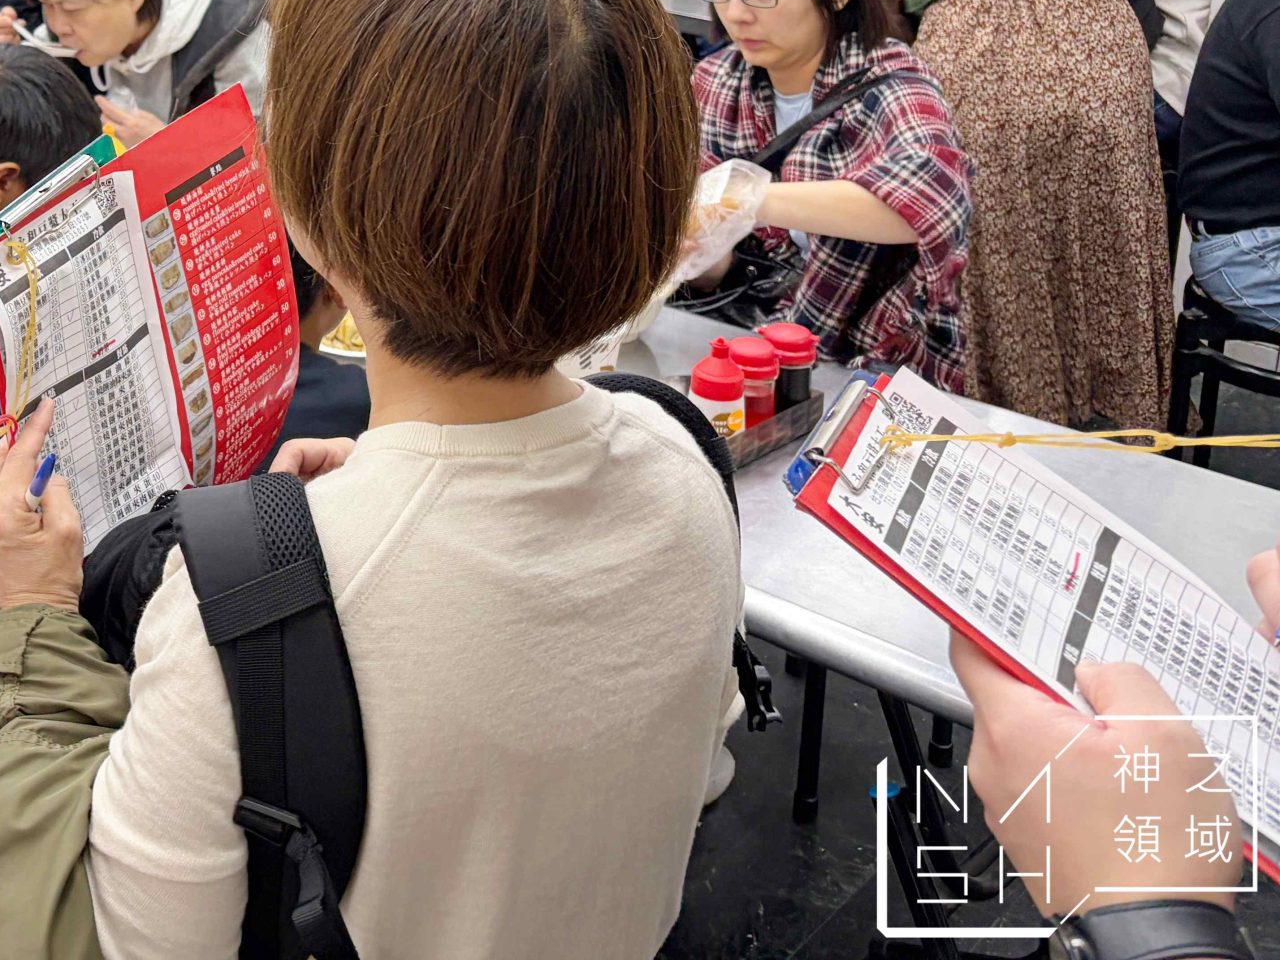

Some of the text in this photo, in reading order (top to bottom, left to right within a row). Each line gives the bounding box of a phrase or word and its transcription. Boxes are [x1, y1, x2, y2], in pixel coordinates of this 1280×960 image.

[256, 183, 265, 195] 60
[228, 207, 271, 241] cake 40
[252, 230, 277, 252] cake 50
[245, 272, 257, 285] cake
[271, 254, 281, 266] 60
[47, 273, 56, 285] 25
[247, 277, 285, 311] cake 30
[279, 300, 289, 313] 50
[51, 319, 60, 332] 35
[283, 323, 292, 336] 40
[53, 331, 62, 344] 40
[53, 343, 63, 355] 50
[54, 408, 63, 420] 20
[55, 419, 65, 433] 20
[144, 427, 153, 439] 40
[59, 438, 68, 450] 25
[146, 449, 155, 461] 60
[62, 456, 71, 467] 30
[65, 466, 74, 478] 40
[151, 471, 160, 483] 40
[155, 482, 164, 494] 30
